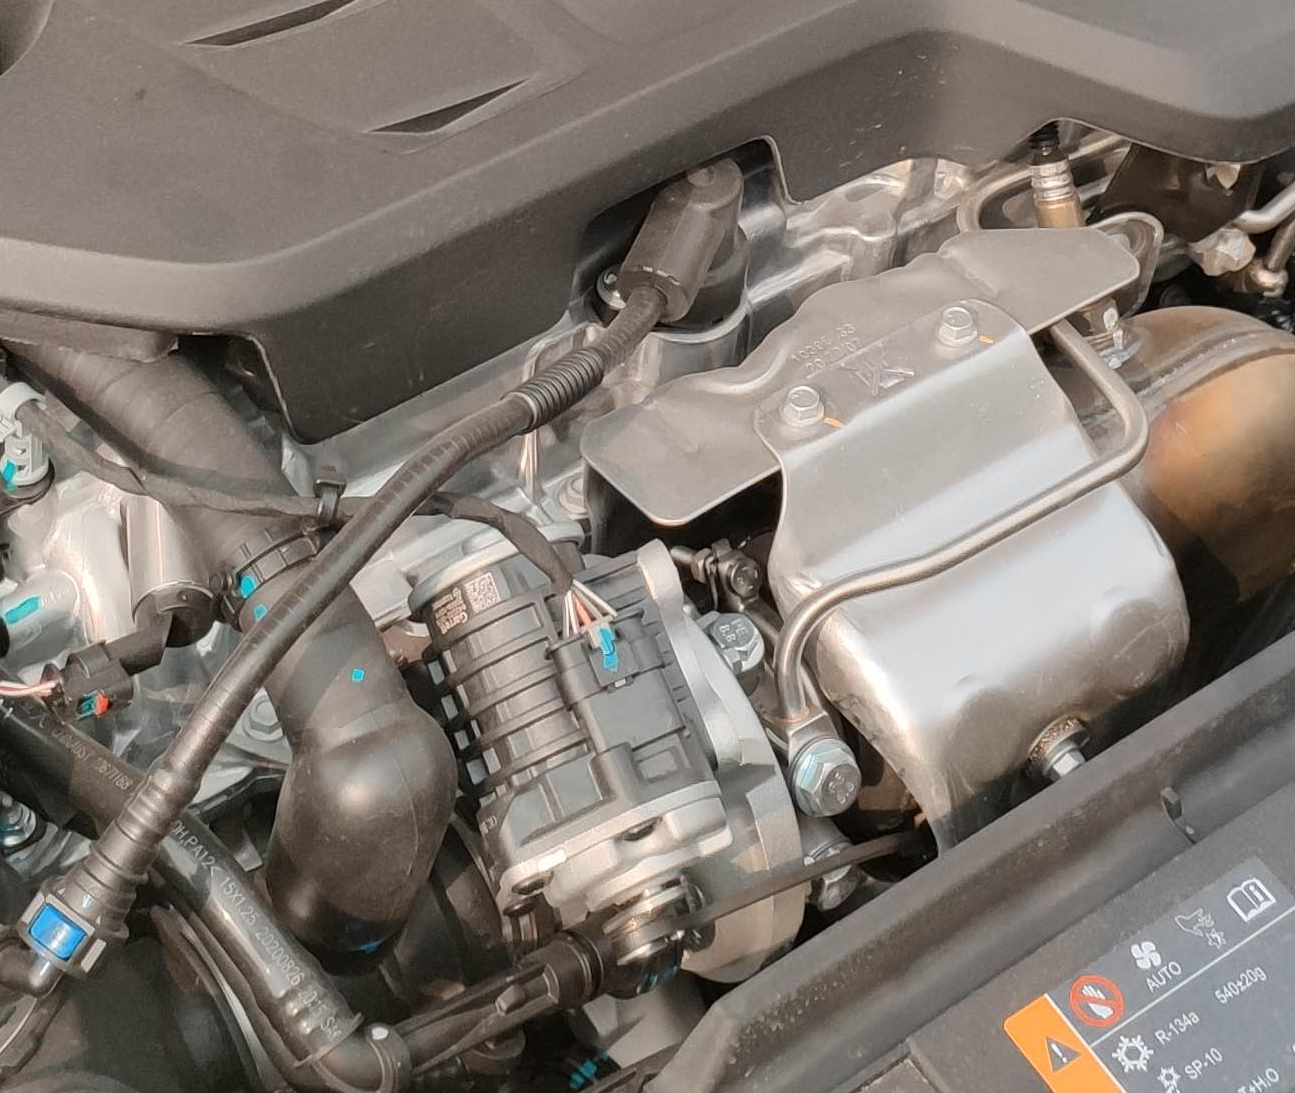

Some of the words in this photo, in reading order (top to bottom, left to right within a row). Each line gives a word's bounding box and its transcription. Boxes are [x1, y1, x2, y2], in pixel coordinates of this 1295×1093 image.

[1145, 960, 1182, 993] AUTO
[1155, 1010, 1200, 1046] R-134a
[1215, 965, 1268, 1004] 540±20g
[1184, 1047, 1224, 1081] SP-10
